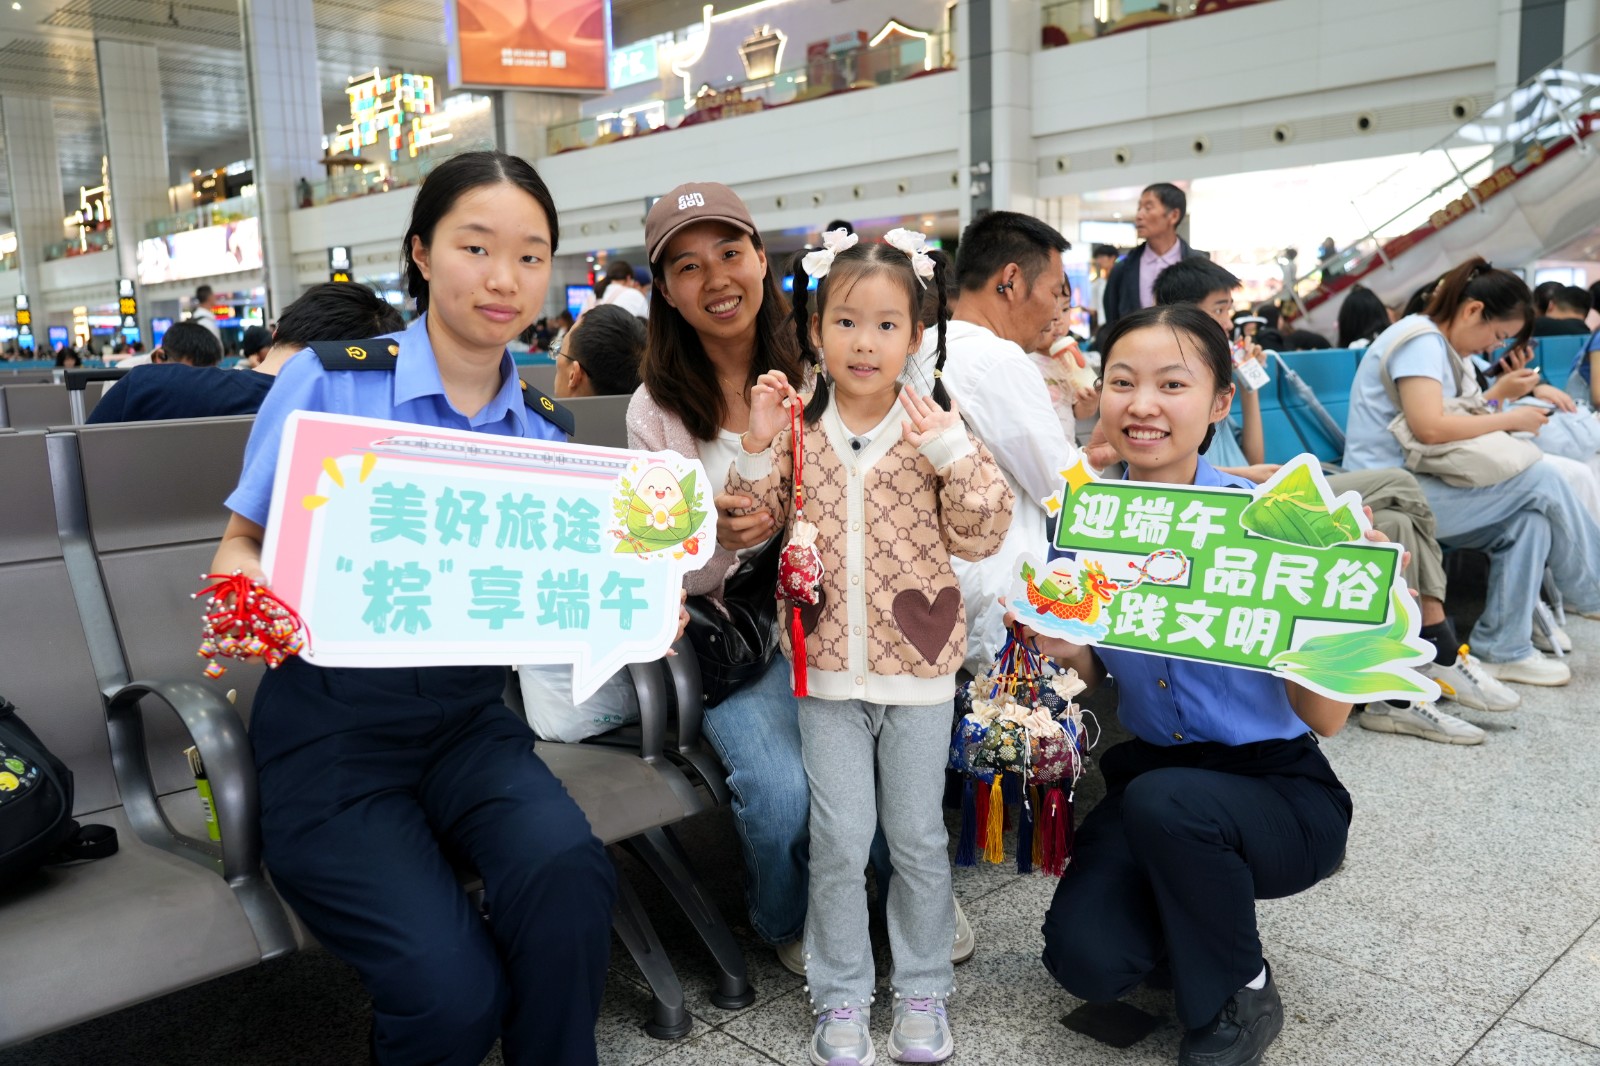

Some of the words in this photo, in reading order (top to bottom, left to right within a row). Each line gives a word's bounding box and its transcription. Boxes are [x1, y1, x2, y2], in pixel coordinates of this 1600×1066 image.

[370, 482, 602, 554] 美好旅途
[1070, 492, 1226, 549] 迎端午
[1204, 546, 1382, 611] 品民俗
[1102, 592, 1281, 657] 践文明
